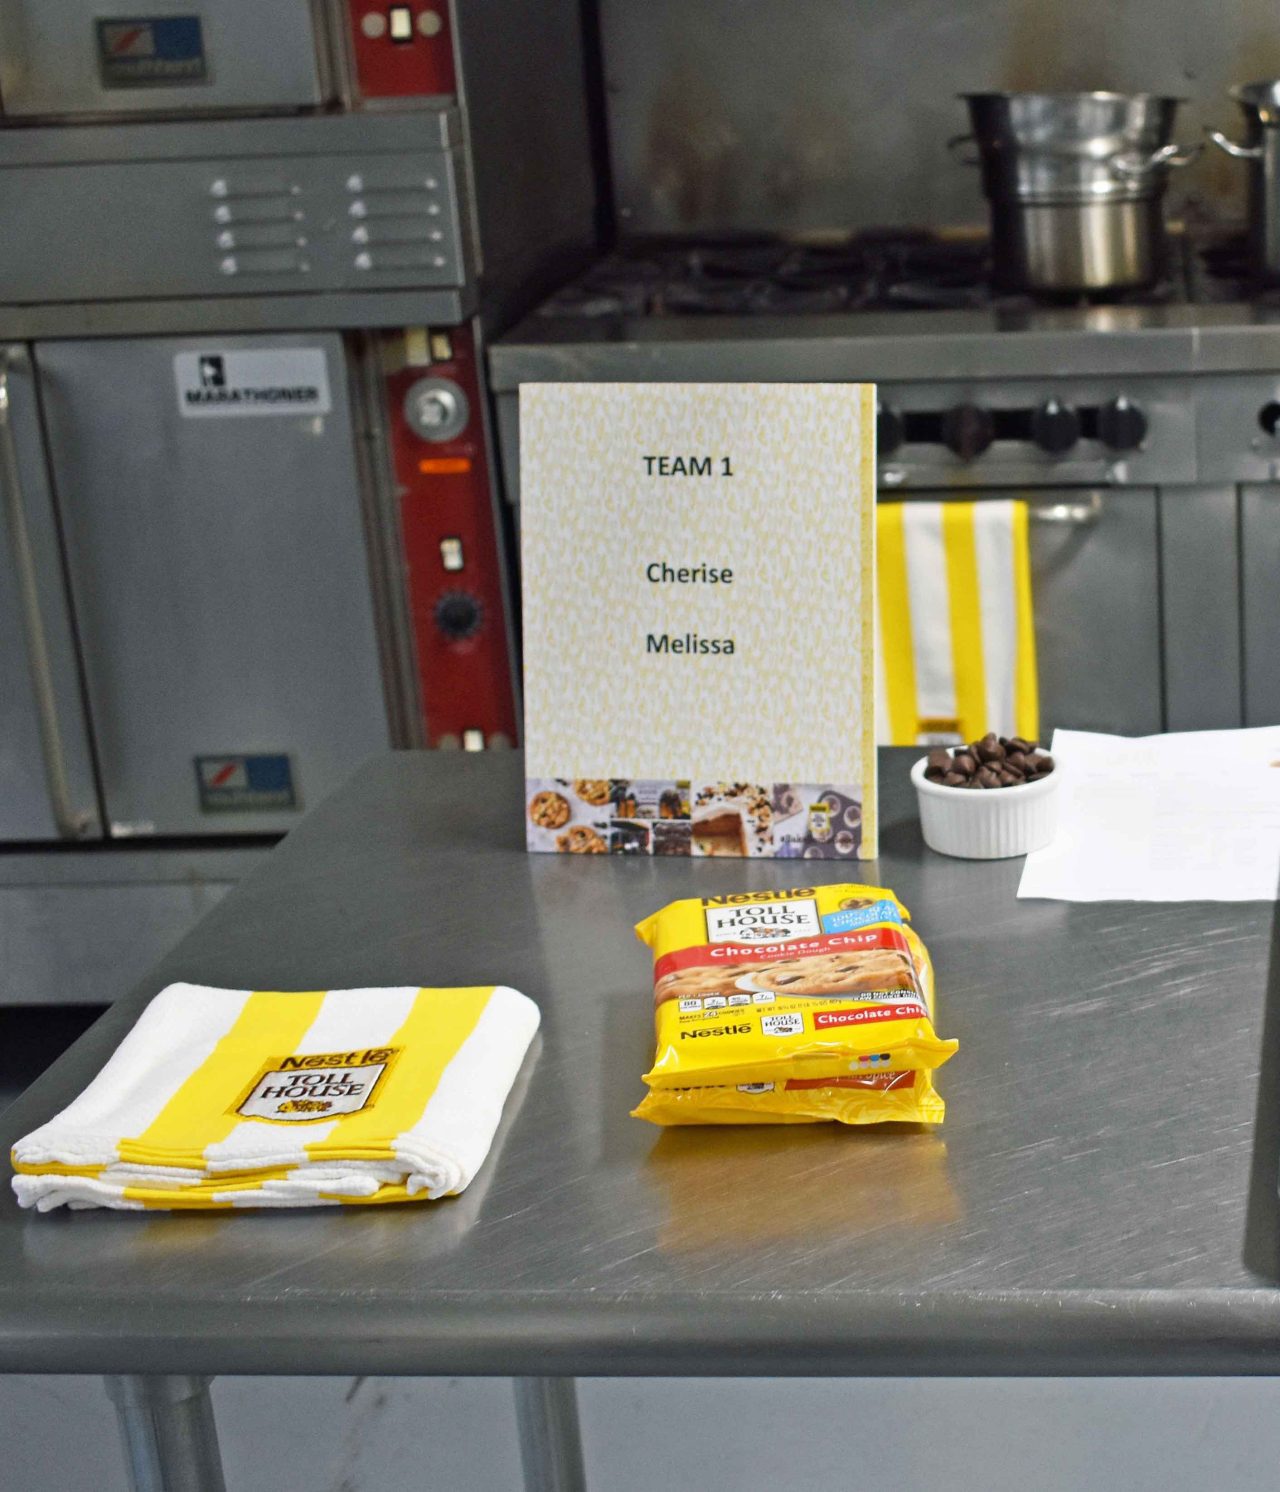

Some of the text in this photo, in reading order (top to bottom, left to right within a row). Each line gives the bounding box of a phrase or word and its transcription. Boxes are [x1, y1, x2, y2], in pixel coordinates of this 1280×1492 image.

[643, 456, 733, 476] TEAM 1
[646, 563, 733, 584] Cherise
[646, 633, 735, 655] Melissa
[729, 906, 795, 917] TOLL
[717, 915, 811, 928] HOUSE
[710, 934, 878, 957] Chocolate Chip
[760, 947, 831, 959] Cookie Dough
[764, 1019, 801, 1027] HOUSE
[817, 1008, 892, 1024] Chocolate
[681, 1022, 752, 1040] Nestlé
[288, 1072, 354, 1086] TOLL
[261, 1083, 365, 1098] HOUSE
